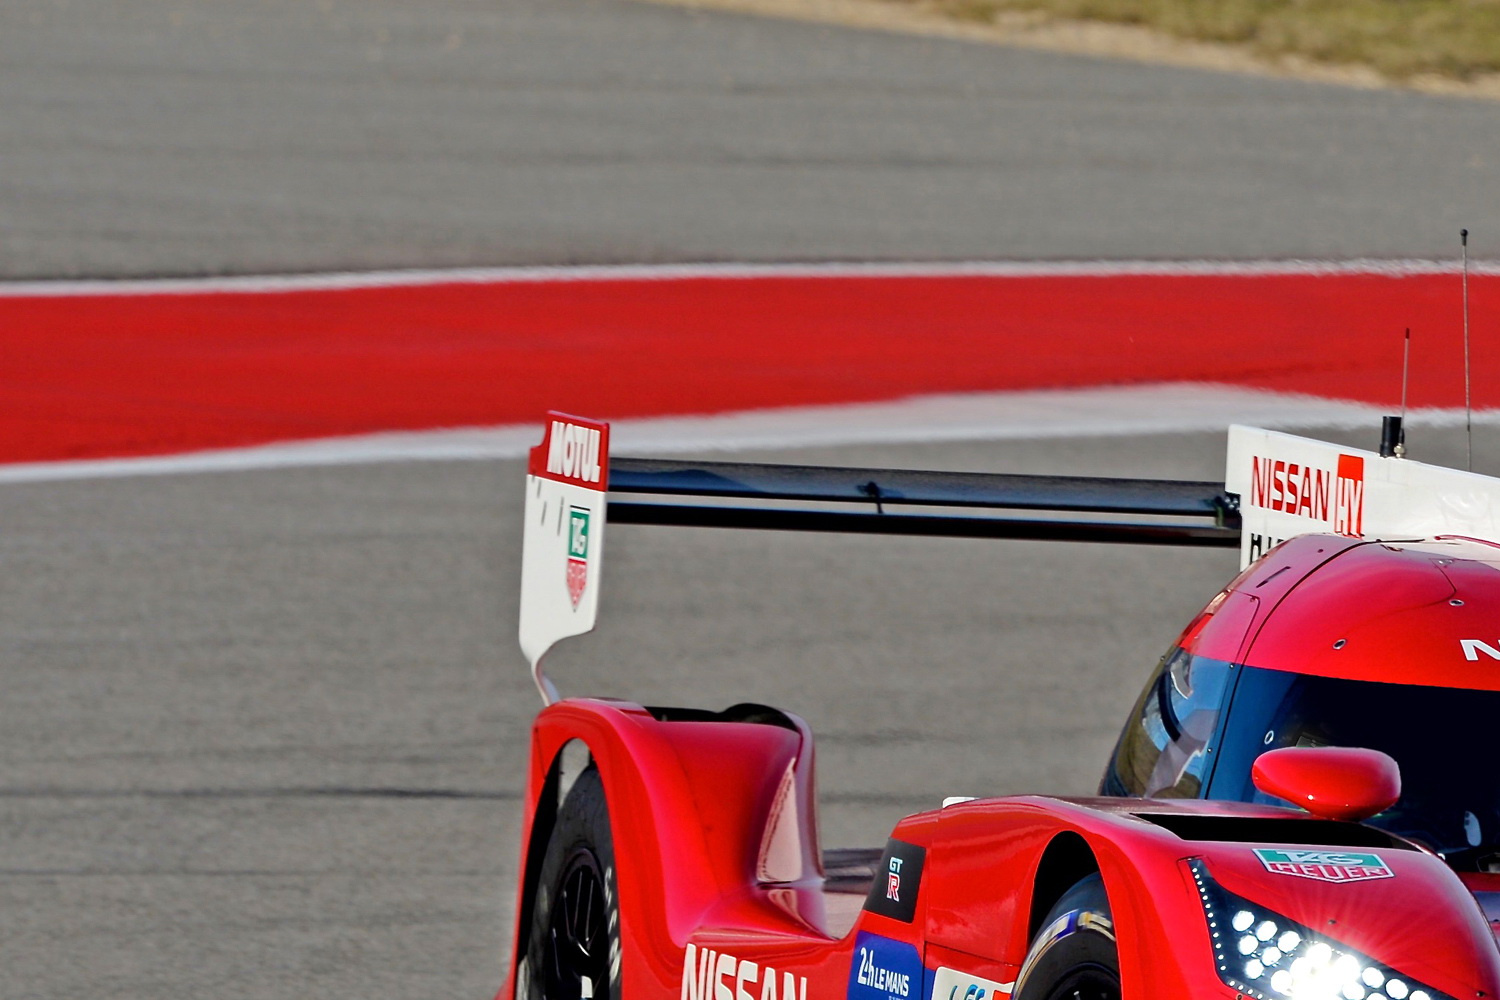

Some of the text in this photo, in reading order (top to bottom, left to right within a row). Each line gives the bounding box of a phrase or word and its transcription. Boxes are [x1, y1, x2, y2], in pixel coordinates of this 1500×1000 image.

[546, 420, 601, 483] MOTUL
[1251, 456, 1364, 538] NISSAN HY
[889, 856, 903, 873] GT
[1275, 863, 1382, 880] HEUER
[1276, 851, 1363, 865] TAG
[886, 872, 900, 902] R
[874, 967, 885, 990] LE
[884, 969, 910, 997] MANS
